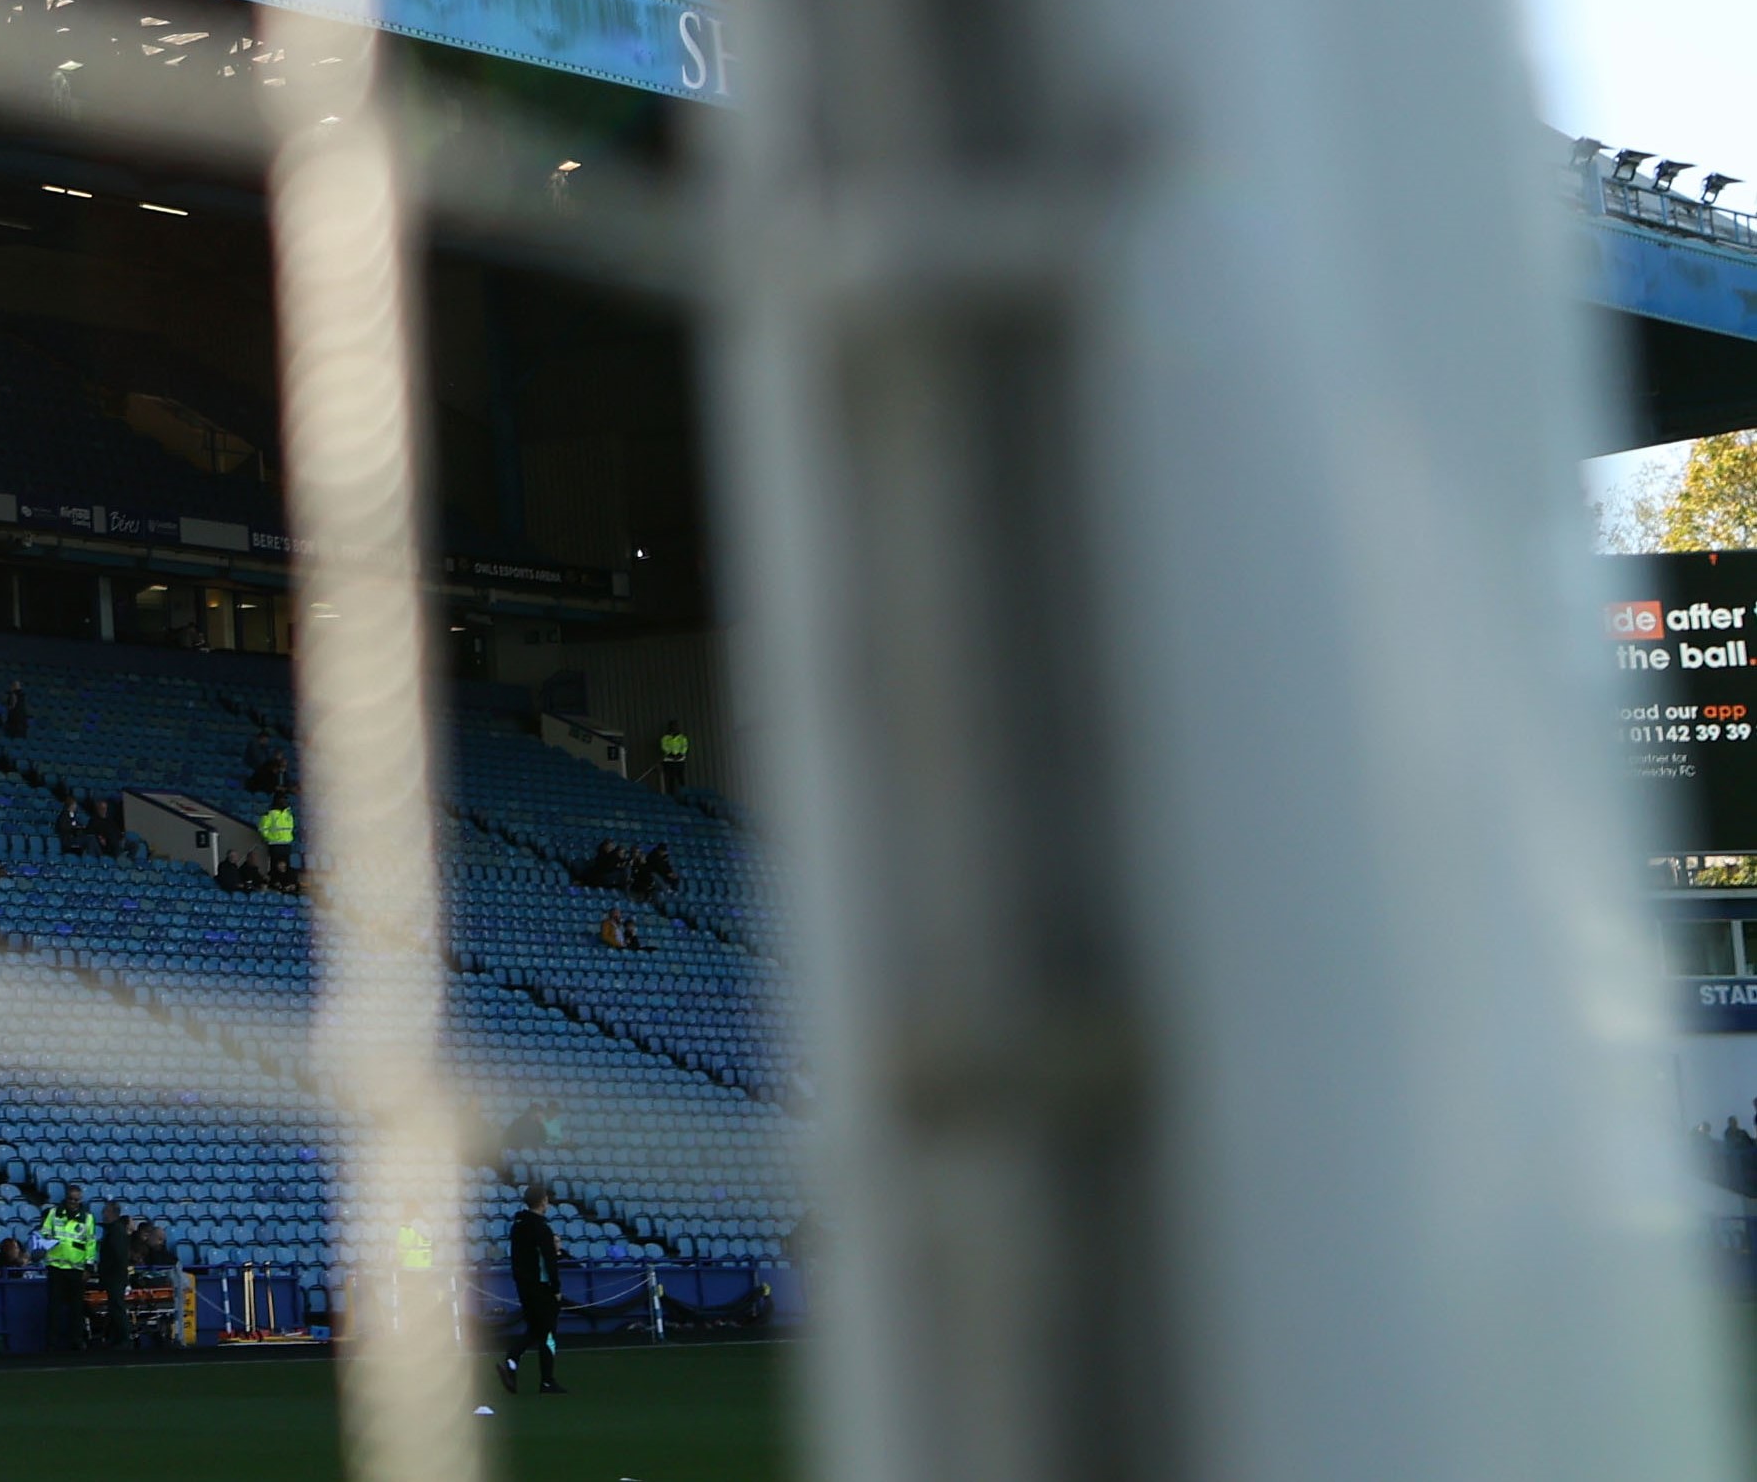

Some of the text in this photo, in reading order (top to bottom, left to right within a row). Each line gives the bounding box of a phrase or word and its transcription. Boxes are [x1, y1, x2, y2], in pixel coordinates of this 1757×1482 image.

[1604, 606, 1657, 633] ide
[1667, 603, 1745, 631] after
[1617, 645, 1671, 670] the
[1619, 704, 1747, 722] oad our app
[1630, 723, 1752, 743] 01142 39 39
